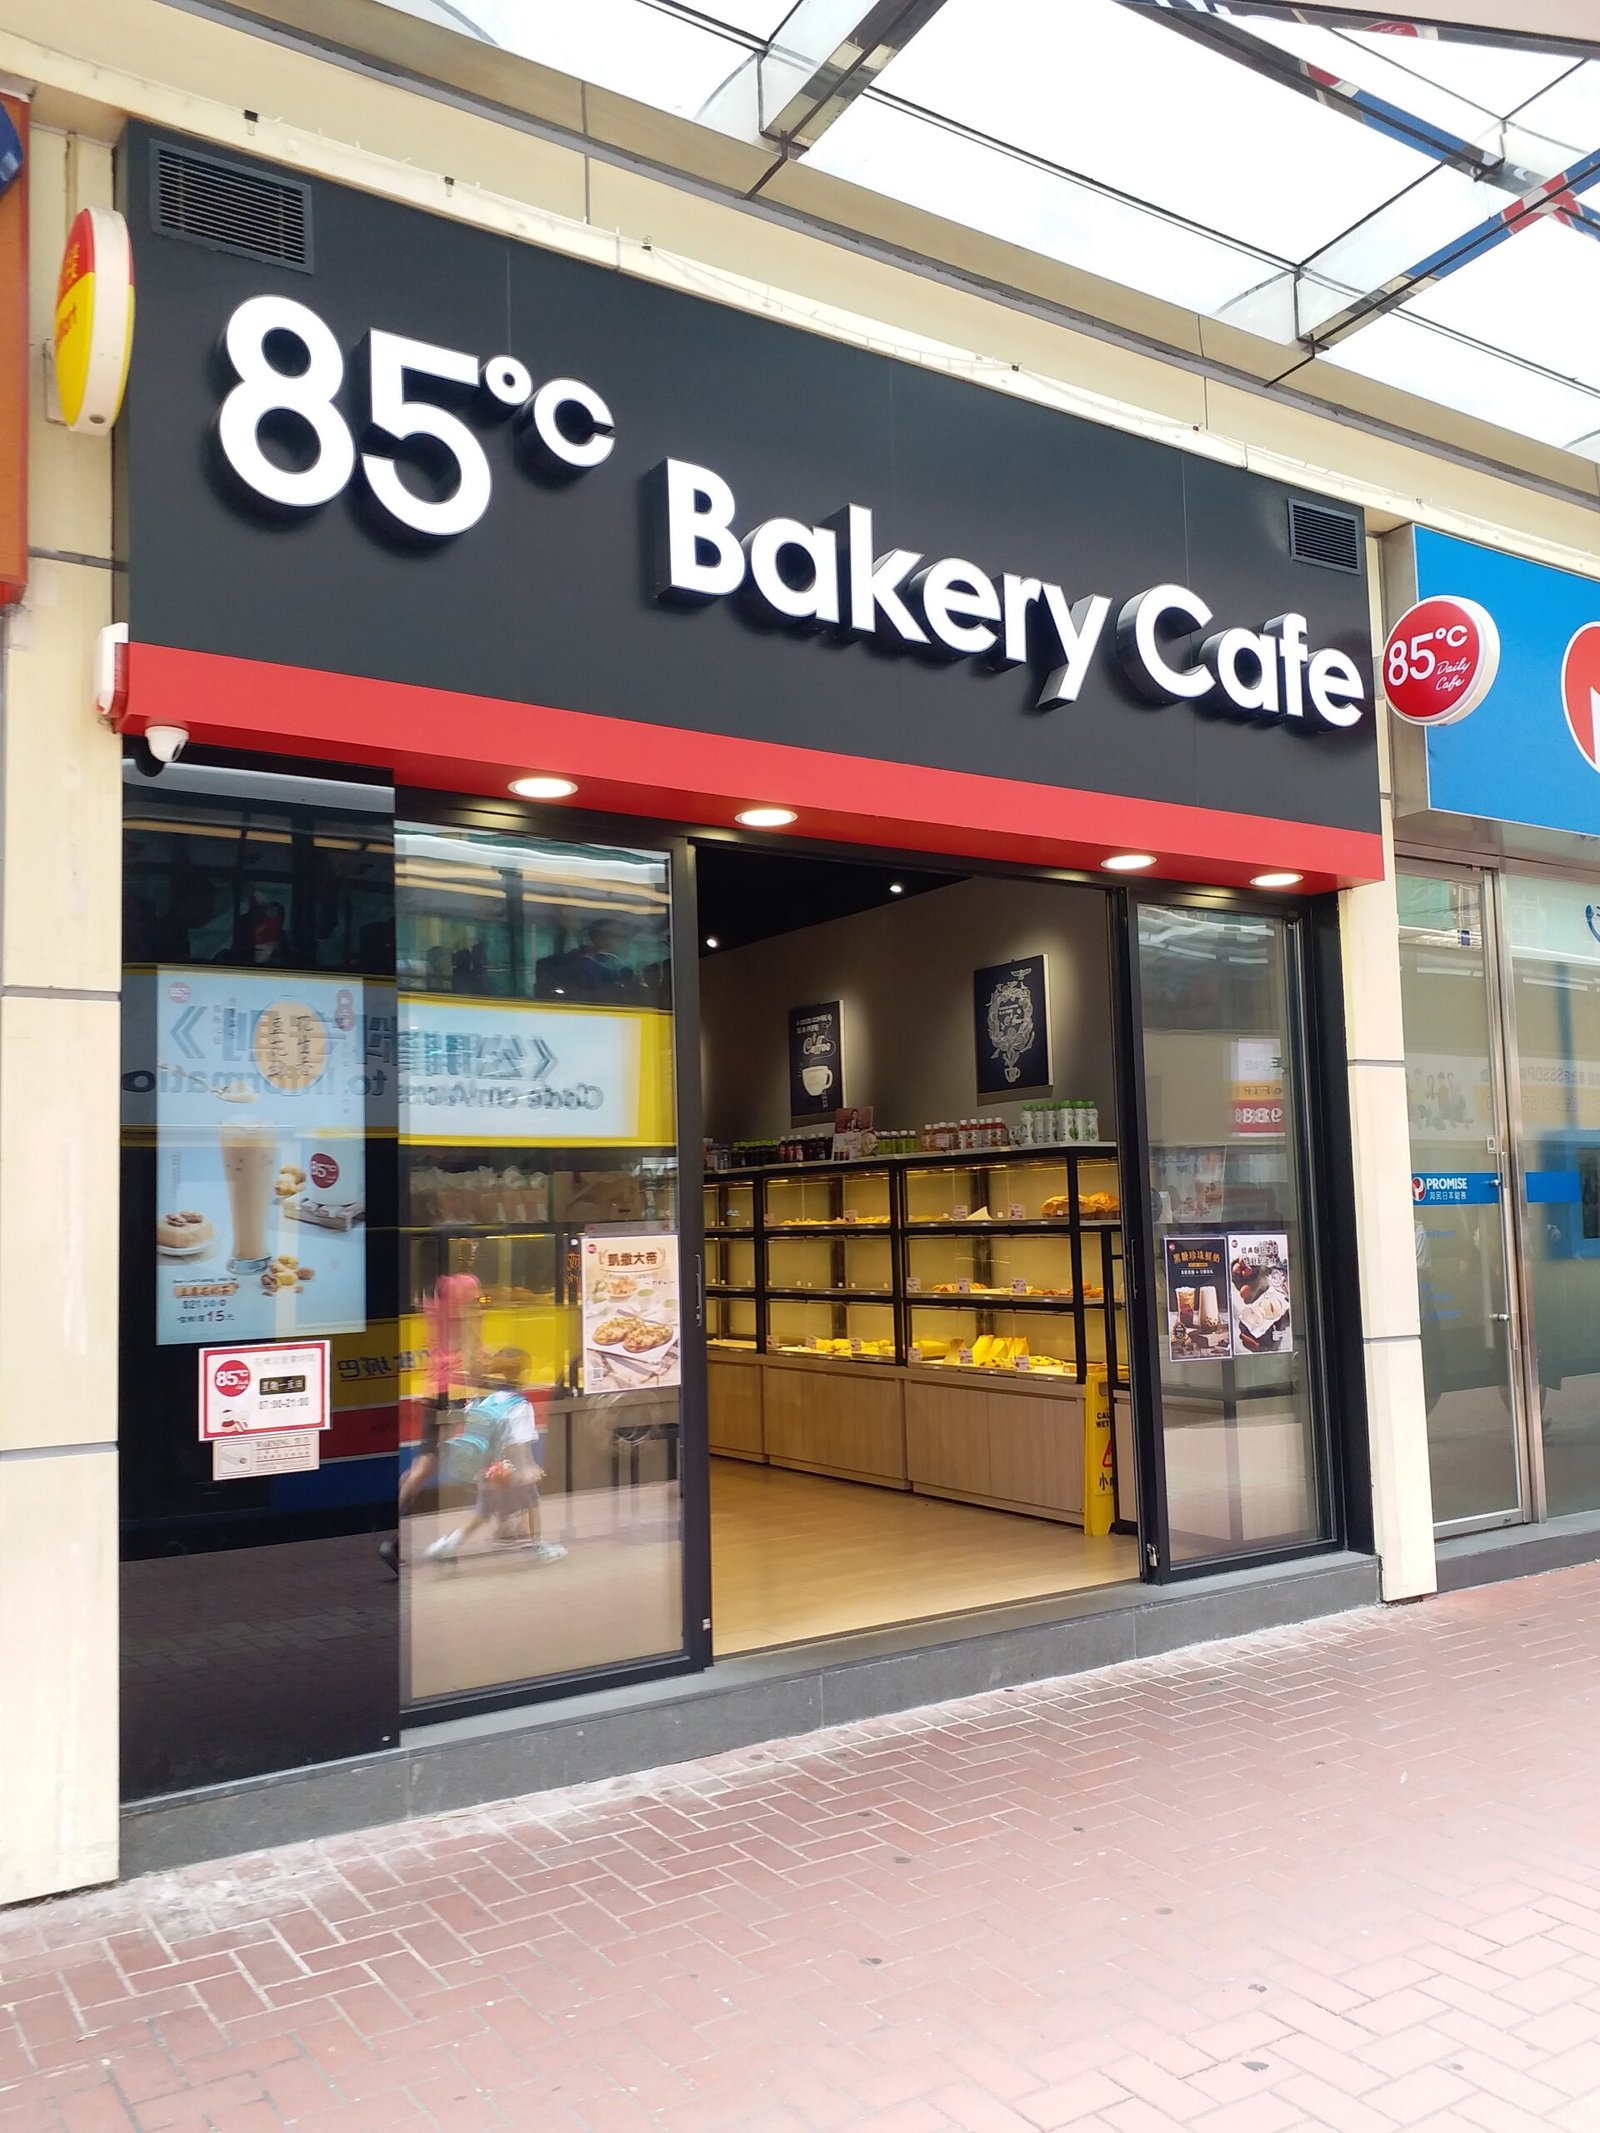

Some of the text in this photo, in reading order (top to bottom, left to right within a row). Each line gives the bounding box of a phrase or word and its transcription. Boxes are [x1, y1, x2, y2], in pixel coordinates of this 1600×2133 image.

[218, 293, 1366, 729] 85°C Bakery Cafe
[1389, 625, 1468, 686] 85°C
[1435, 658, 1472, 676] Daily
[1435, 676, 1465, 692] Cafe
[1426, 1178, 1467, 1189] PROMISE
